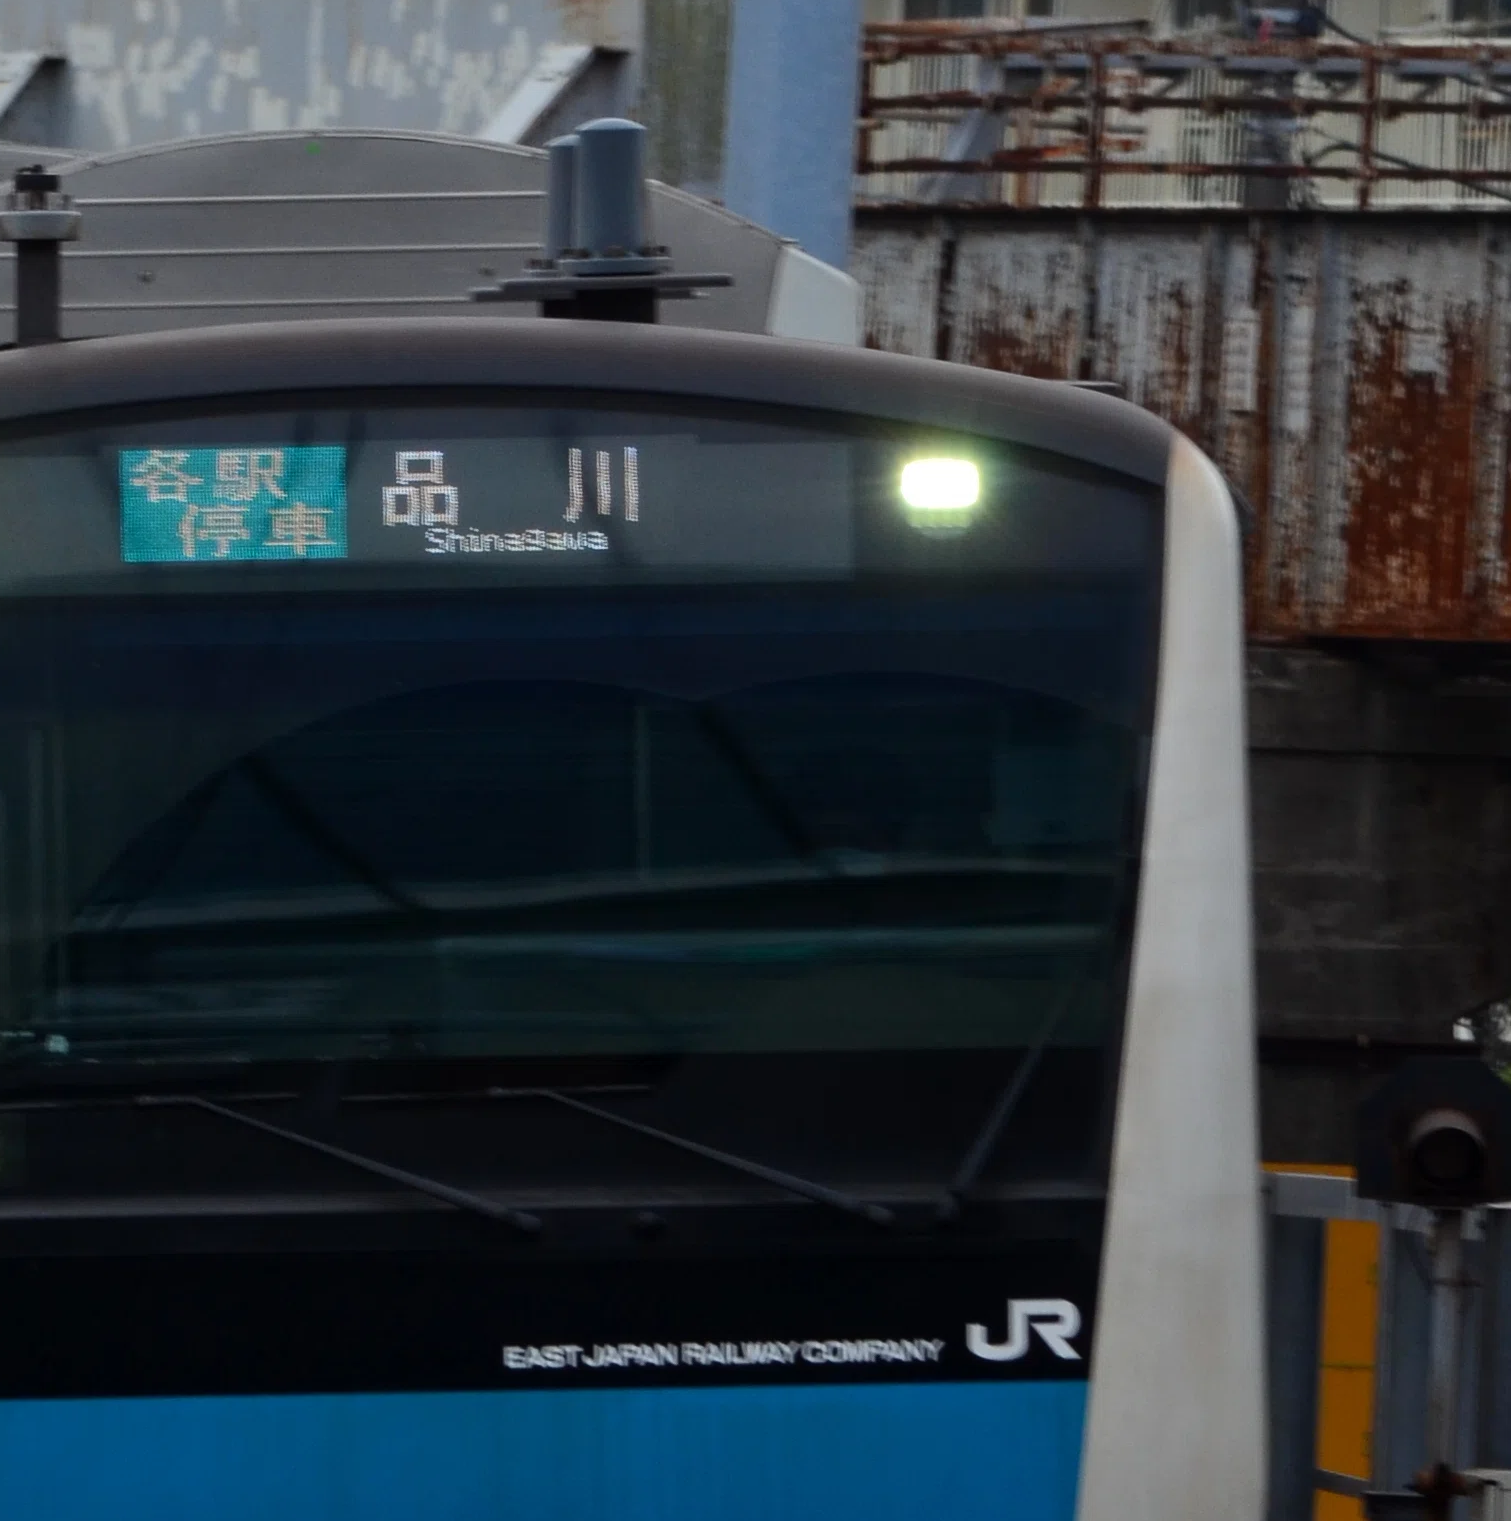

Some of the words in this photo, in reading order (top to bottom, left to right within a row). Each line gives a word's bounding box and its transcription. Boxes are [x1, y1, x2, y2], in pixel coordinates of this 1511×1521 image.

[129, 448, 288, 504] 各駅
[177, 503, 337, 558] 停車
[424, 527, 609, 555] Shinagawa
[502, 1345, 582, 1370] EAST
[586, 1343, 678, 1368] JAPAN
[681, 1341, 799, 1366] RAILWAY
[800, 1339, 945, 1364] COMPANY
[964, 1298, 1083, 1362] JR
